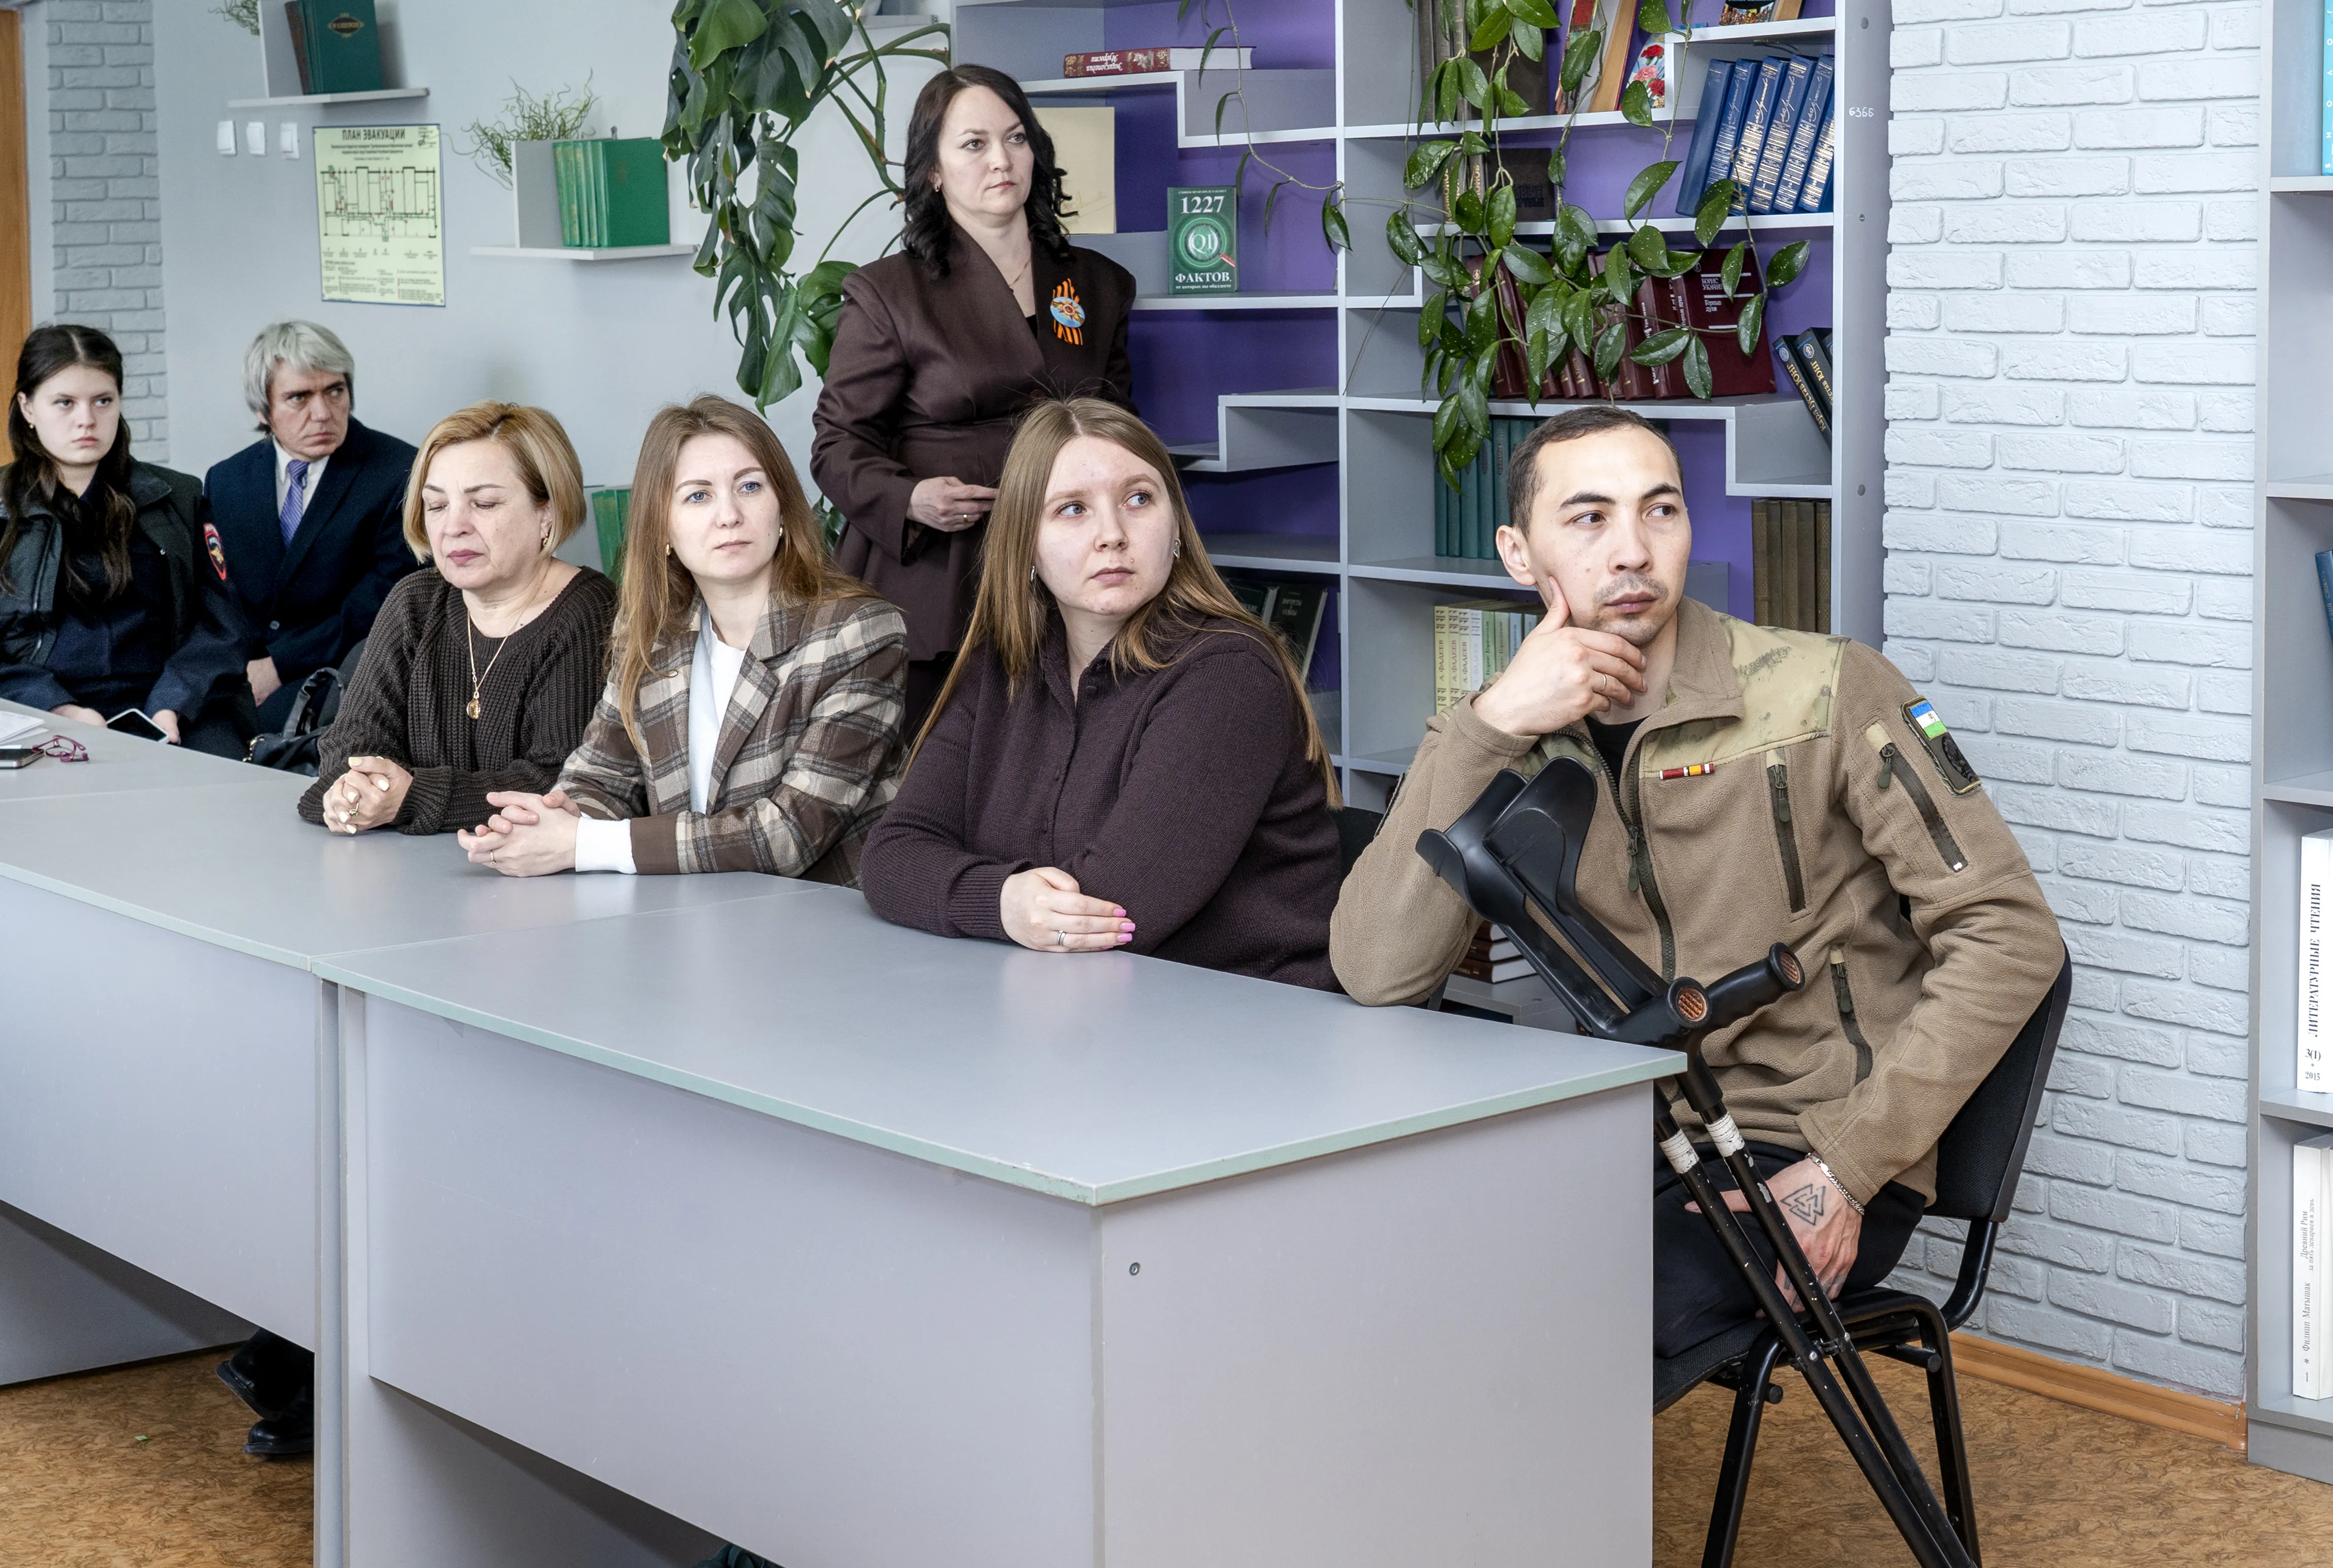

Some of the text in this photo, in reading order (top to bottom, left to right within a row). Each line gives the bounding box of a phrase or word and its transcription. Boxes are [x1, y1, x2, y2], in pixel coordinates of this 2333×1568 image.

[342, 129, 360, 141] ПЛАН
[363, 128, 406, 142] ЭВАКУАЦИИ
[1180, 195, 1224, 214] 1227
[1191, 233, 1214, 254] QI
[1810, 360, 1825, 382] ЮНГ
[1786, 363, 1826, 431] Карл Густав ЮНГ
[2309, 883, 2321, 1038] ЛИТЕРАТУРНЫЕ ЧТЕНИЯ
[2305, 1048, 2321, 1062] 3(1)
[2305, 1071, 2320, 1081] 2015
[2300, 1227, 2309, 1259] Древний
[2302, 1282, 2311, 1352] Филипп Матышак
[2305, 1372, 2309, 1382] 1
